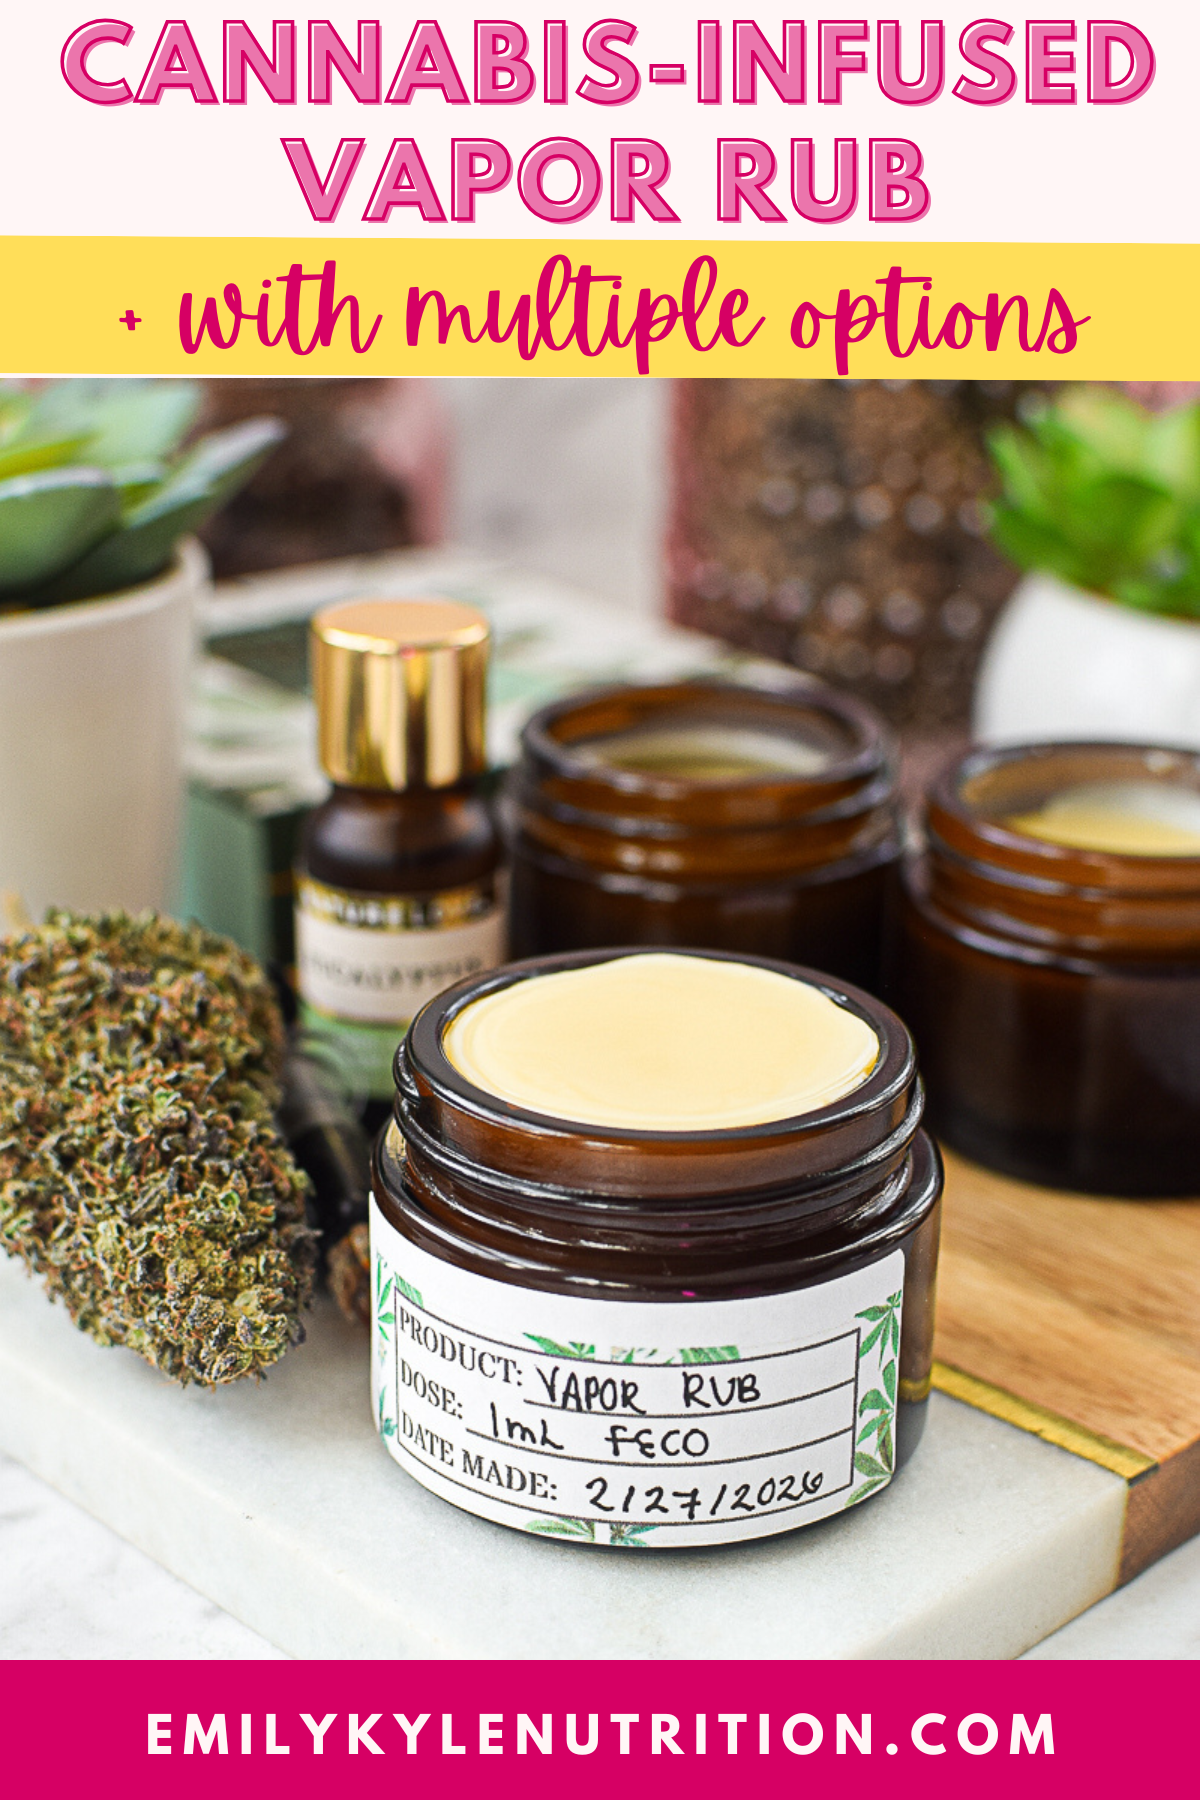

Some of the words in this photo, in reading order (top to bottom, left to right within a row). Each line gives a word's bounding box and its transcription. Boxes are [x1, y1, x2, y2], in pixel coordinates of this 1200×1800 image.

[400, 1305, 523, 1387] PRODUCT:
[534, 1363, 648, 1416] VAPOR
[682, 1370, 762, 1408] RUB
[401, 1358, 463, 1420] DOSE:
[604, 1424, 710, 1458] FECO
[402, 1409, 455, 1467] DATE
[461, 1448, 558, 1501] MADE:
